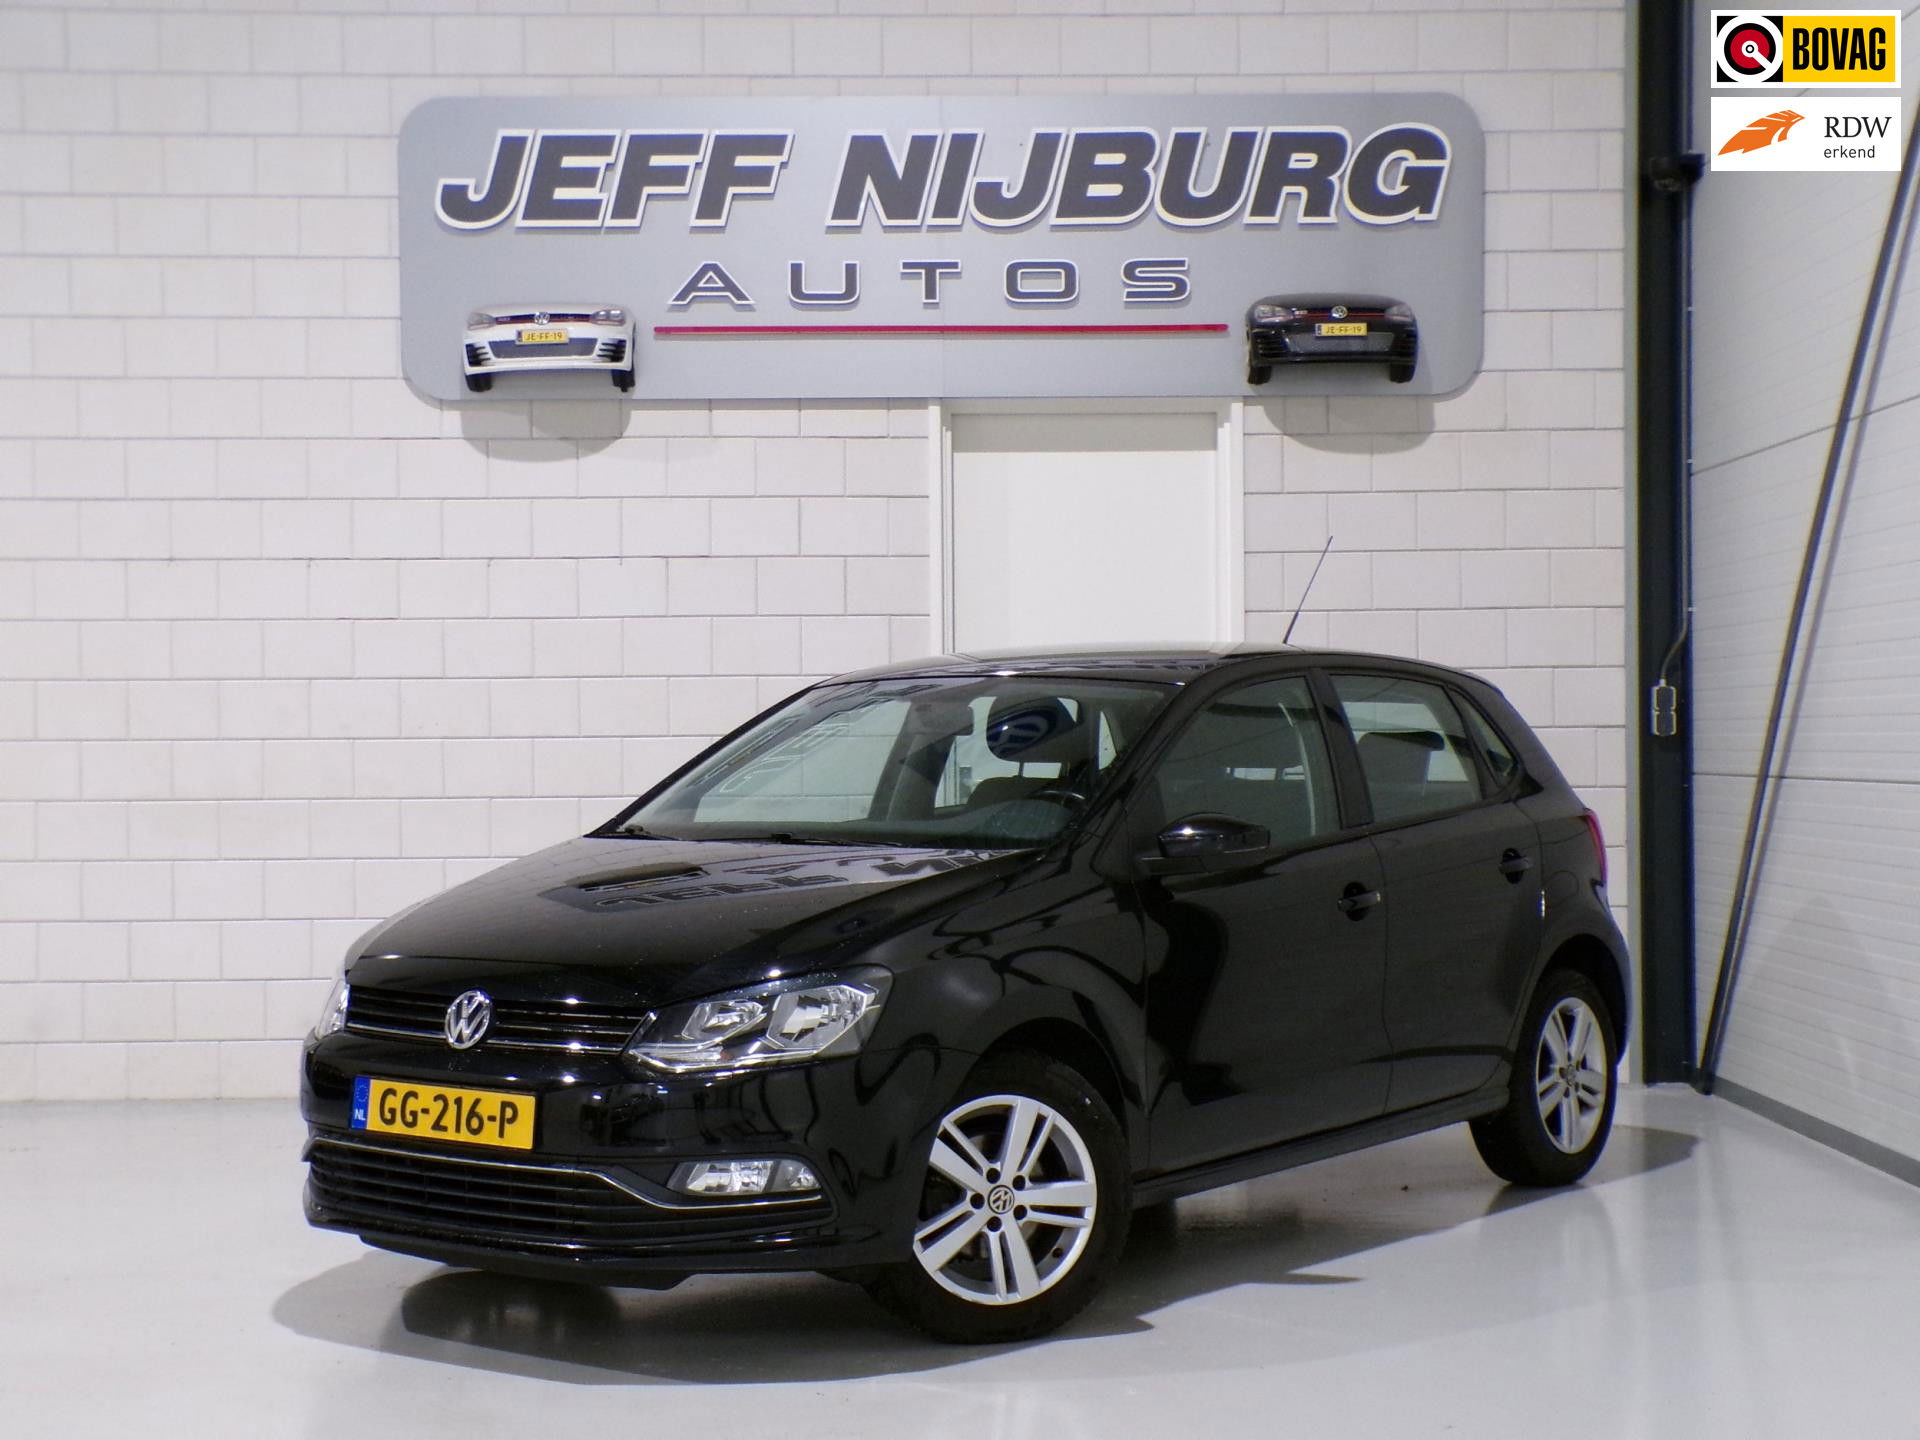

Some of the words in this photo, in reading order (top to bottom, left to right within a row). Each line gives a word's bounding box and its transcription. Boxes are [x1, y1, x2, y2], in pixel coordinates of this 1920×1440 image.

[435, 129, 795, 228] JEFF
[825, 123, 1451, 227] NIJBURG
[669, 259, 1191, 304] AUTOS
[379, 1087, 519, 1139] GG-216-P
